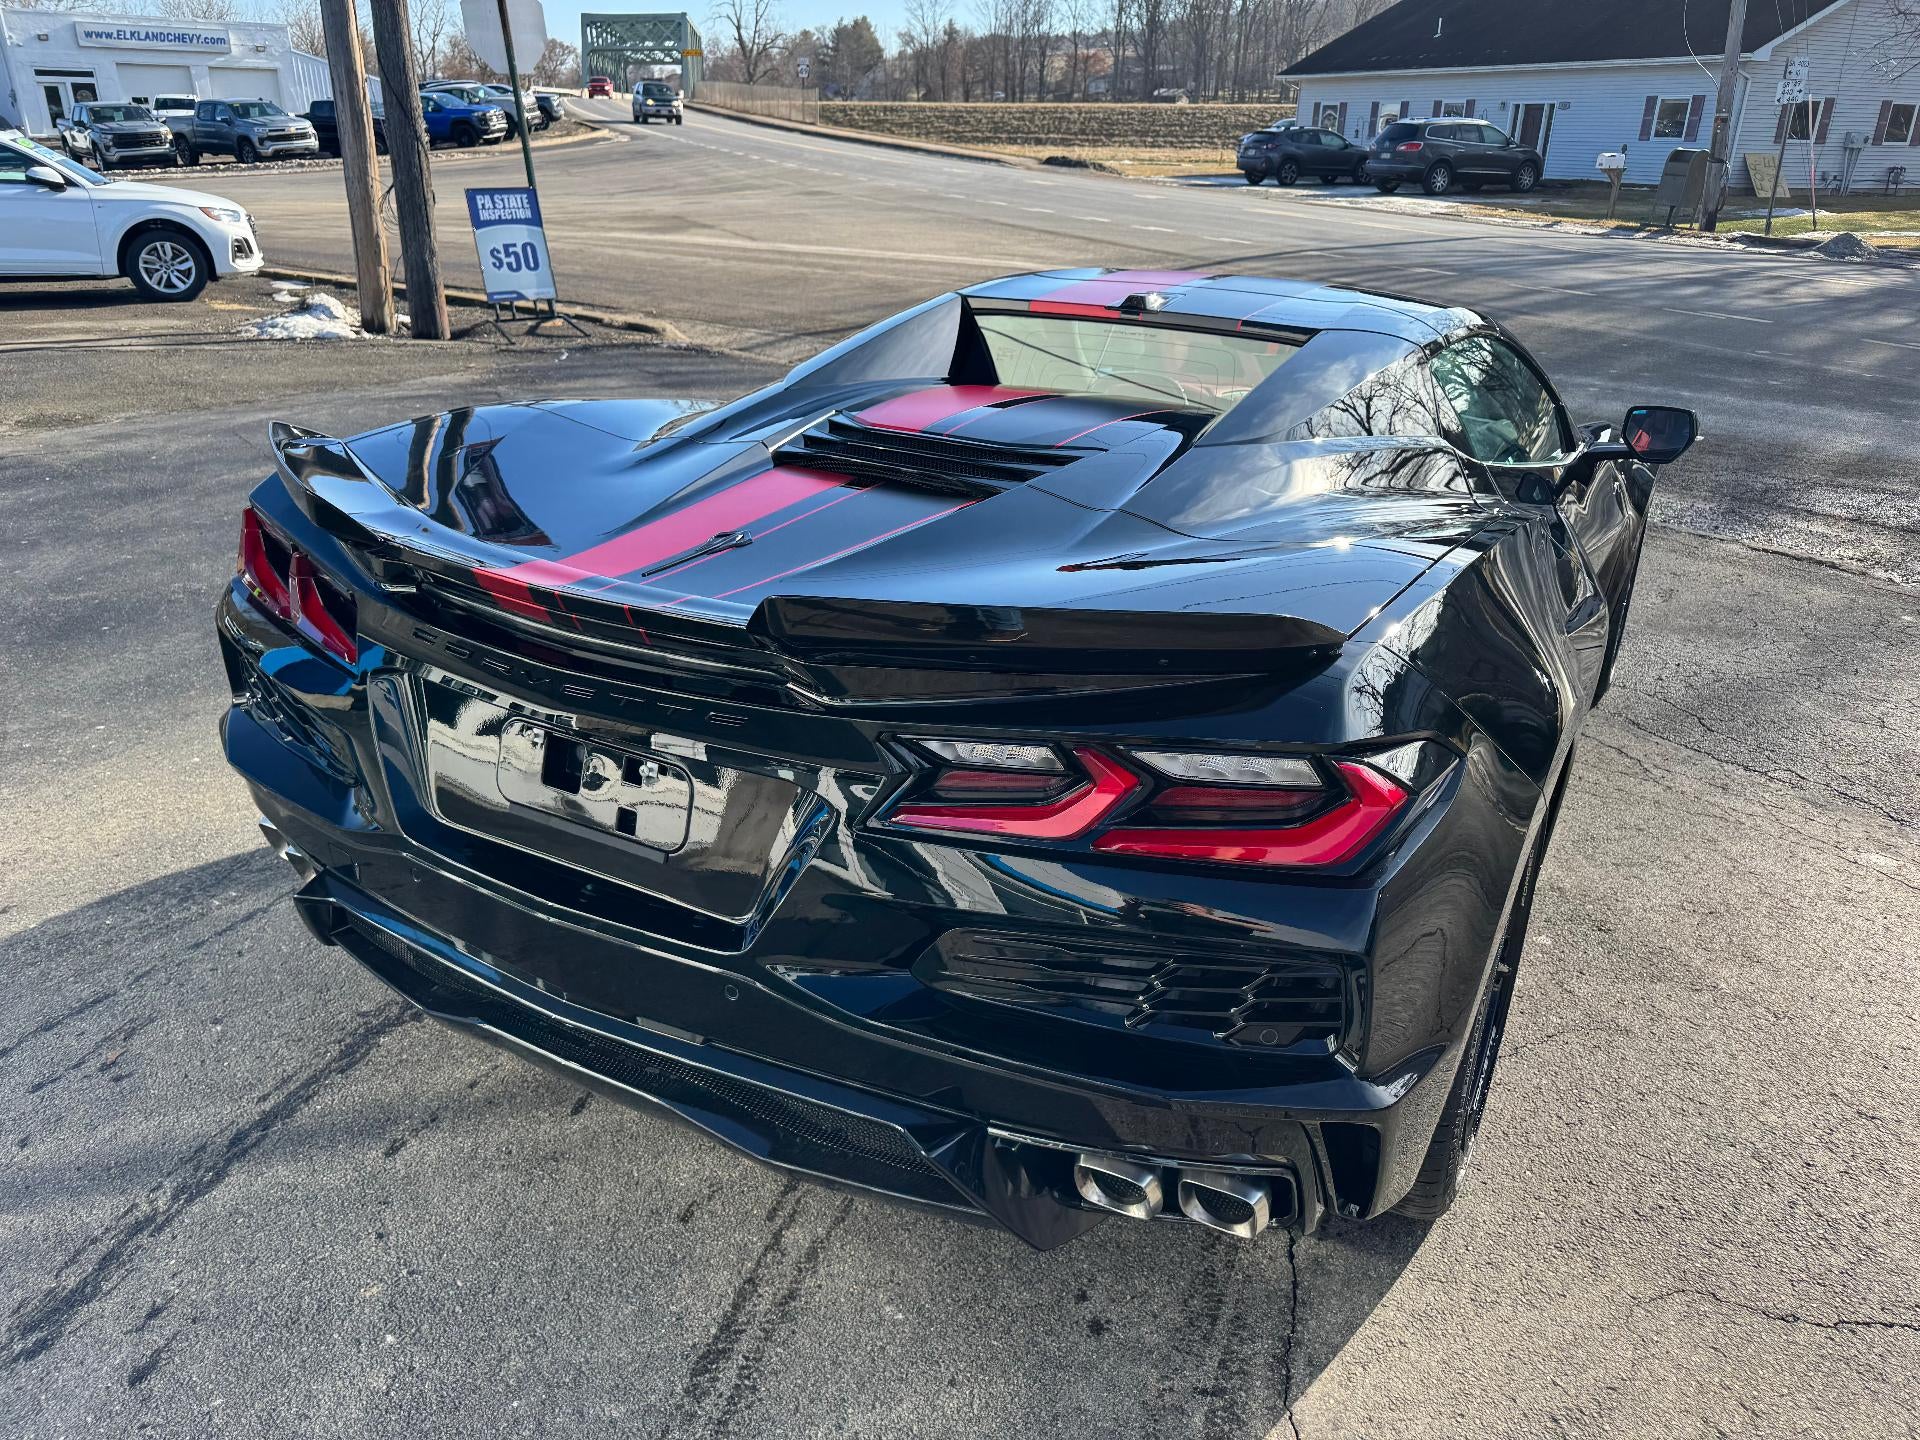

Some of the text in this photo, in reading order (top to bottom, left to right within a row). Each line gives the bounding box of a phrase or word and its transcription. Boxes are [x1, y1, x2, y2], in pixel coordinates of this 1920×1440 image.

[84, 29, 226, 45] www.ELKLANDCHEVY.com
[1782, 81, 1791, 89] SR
[476, 193, 530, 209] PA STATE
[479, 208, 532, 221] INSPECTION
[489, 241, 540, 273] $50
[412, 627, 749, 727] CORVETTE
